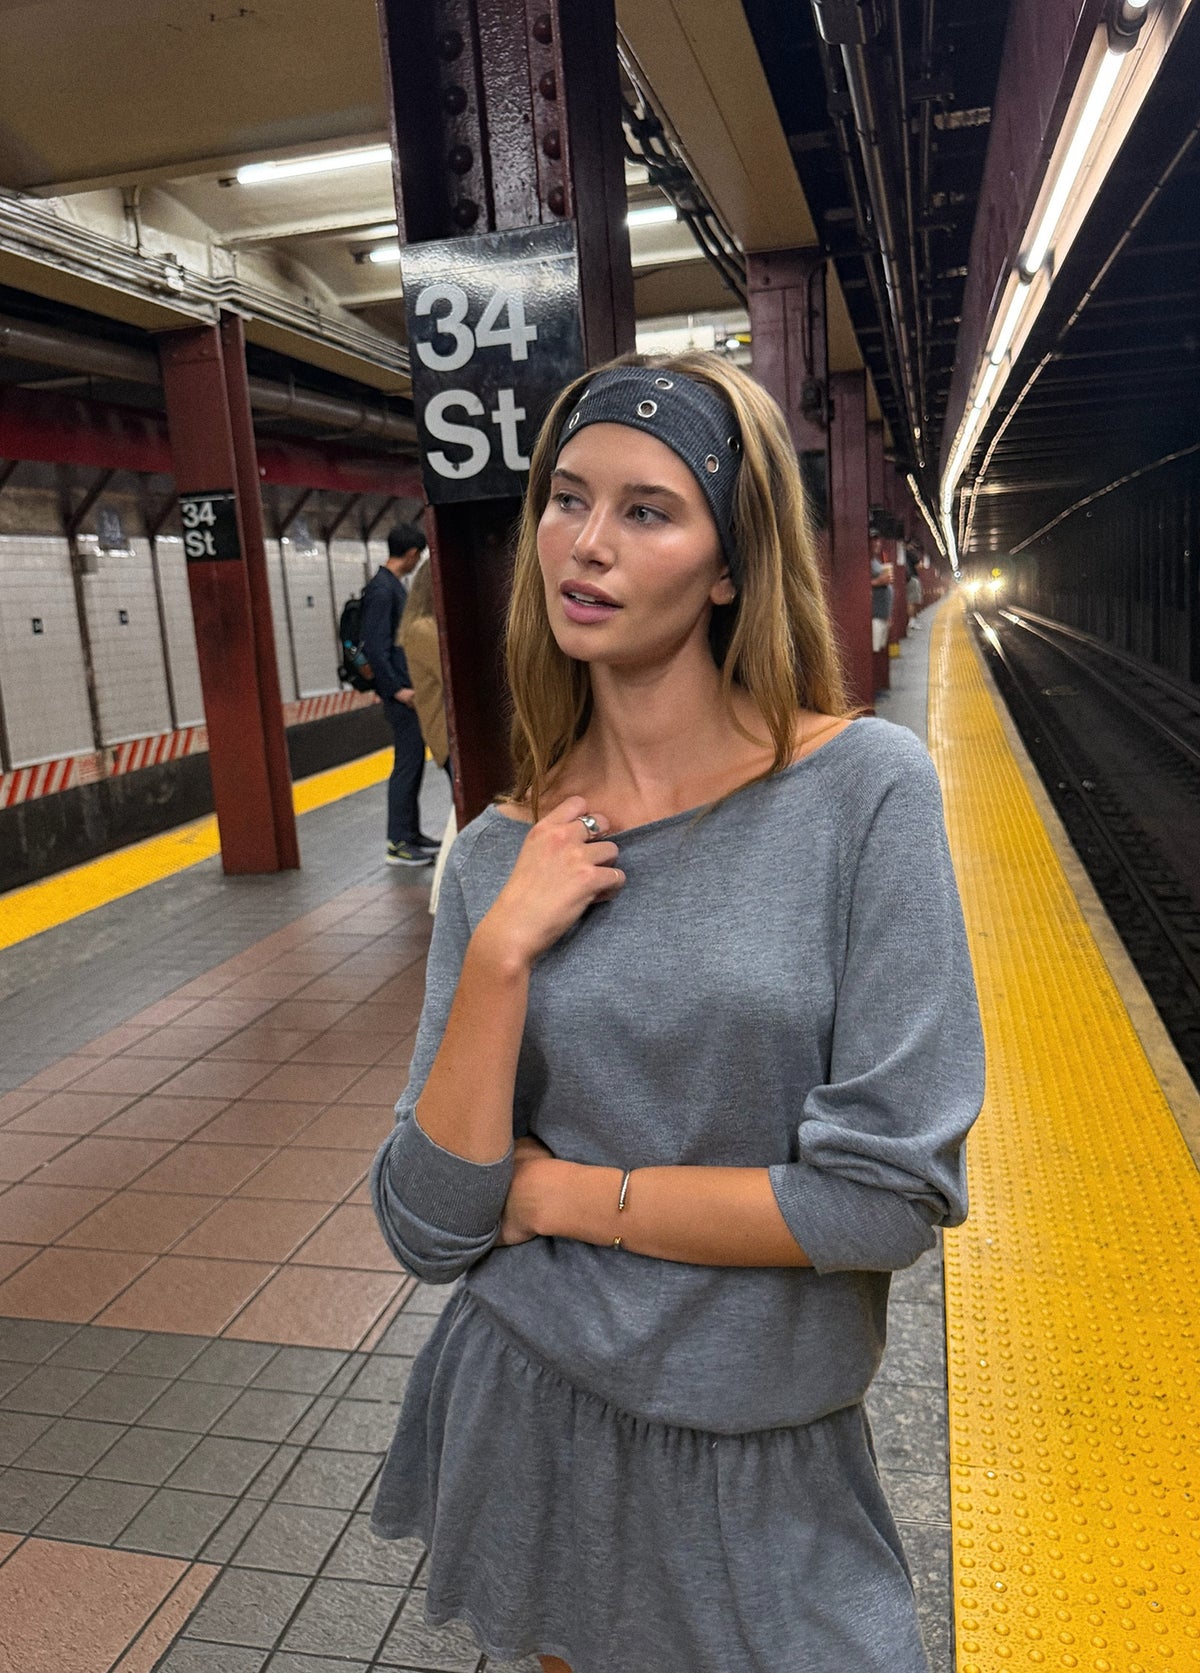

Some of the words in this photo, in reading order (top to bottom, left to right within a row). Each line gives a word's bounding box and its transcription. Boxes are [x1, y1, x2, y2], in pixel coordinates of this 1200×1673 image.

[415, 284, 537, 371] 34
[424, 389, 530, 479] St
[182, 501, 216, 528] 34
[186, 530, 216, 557] St
